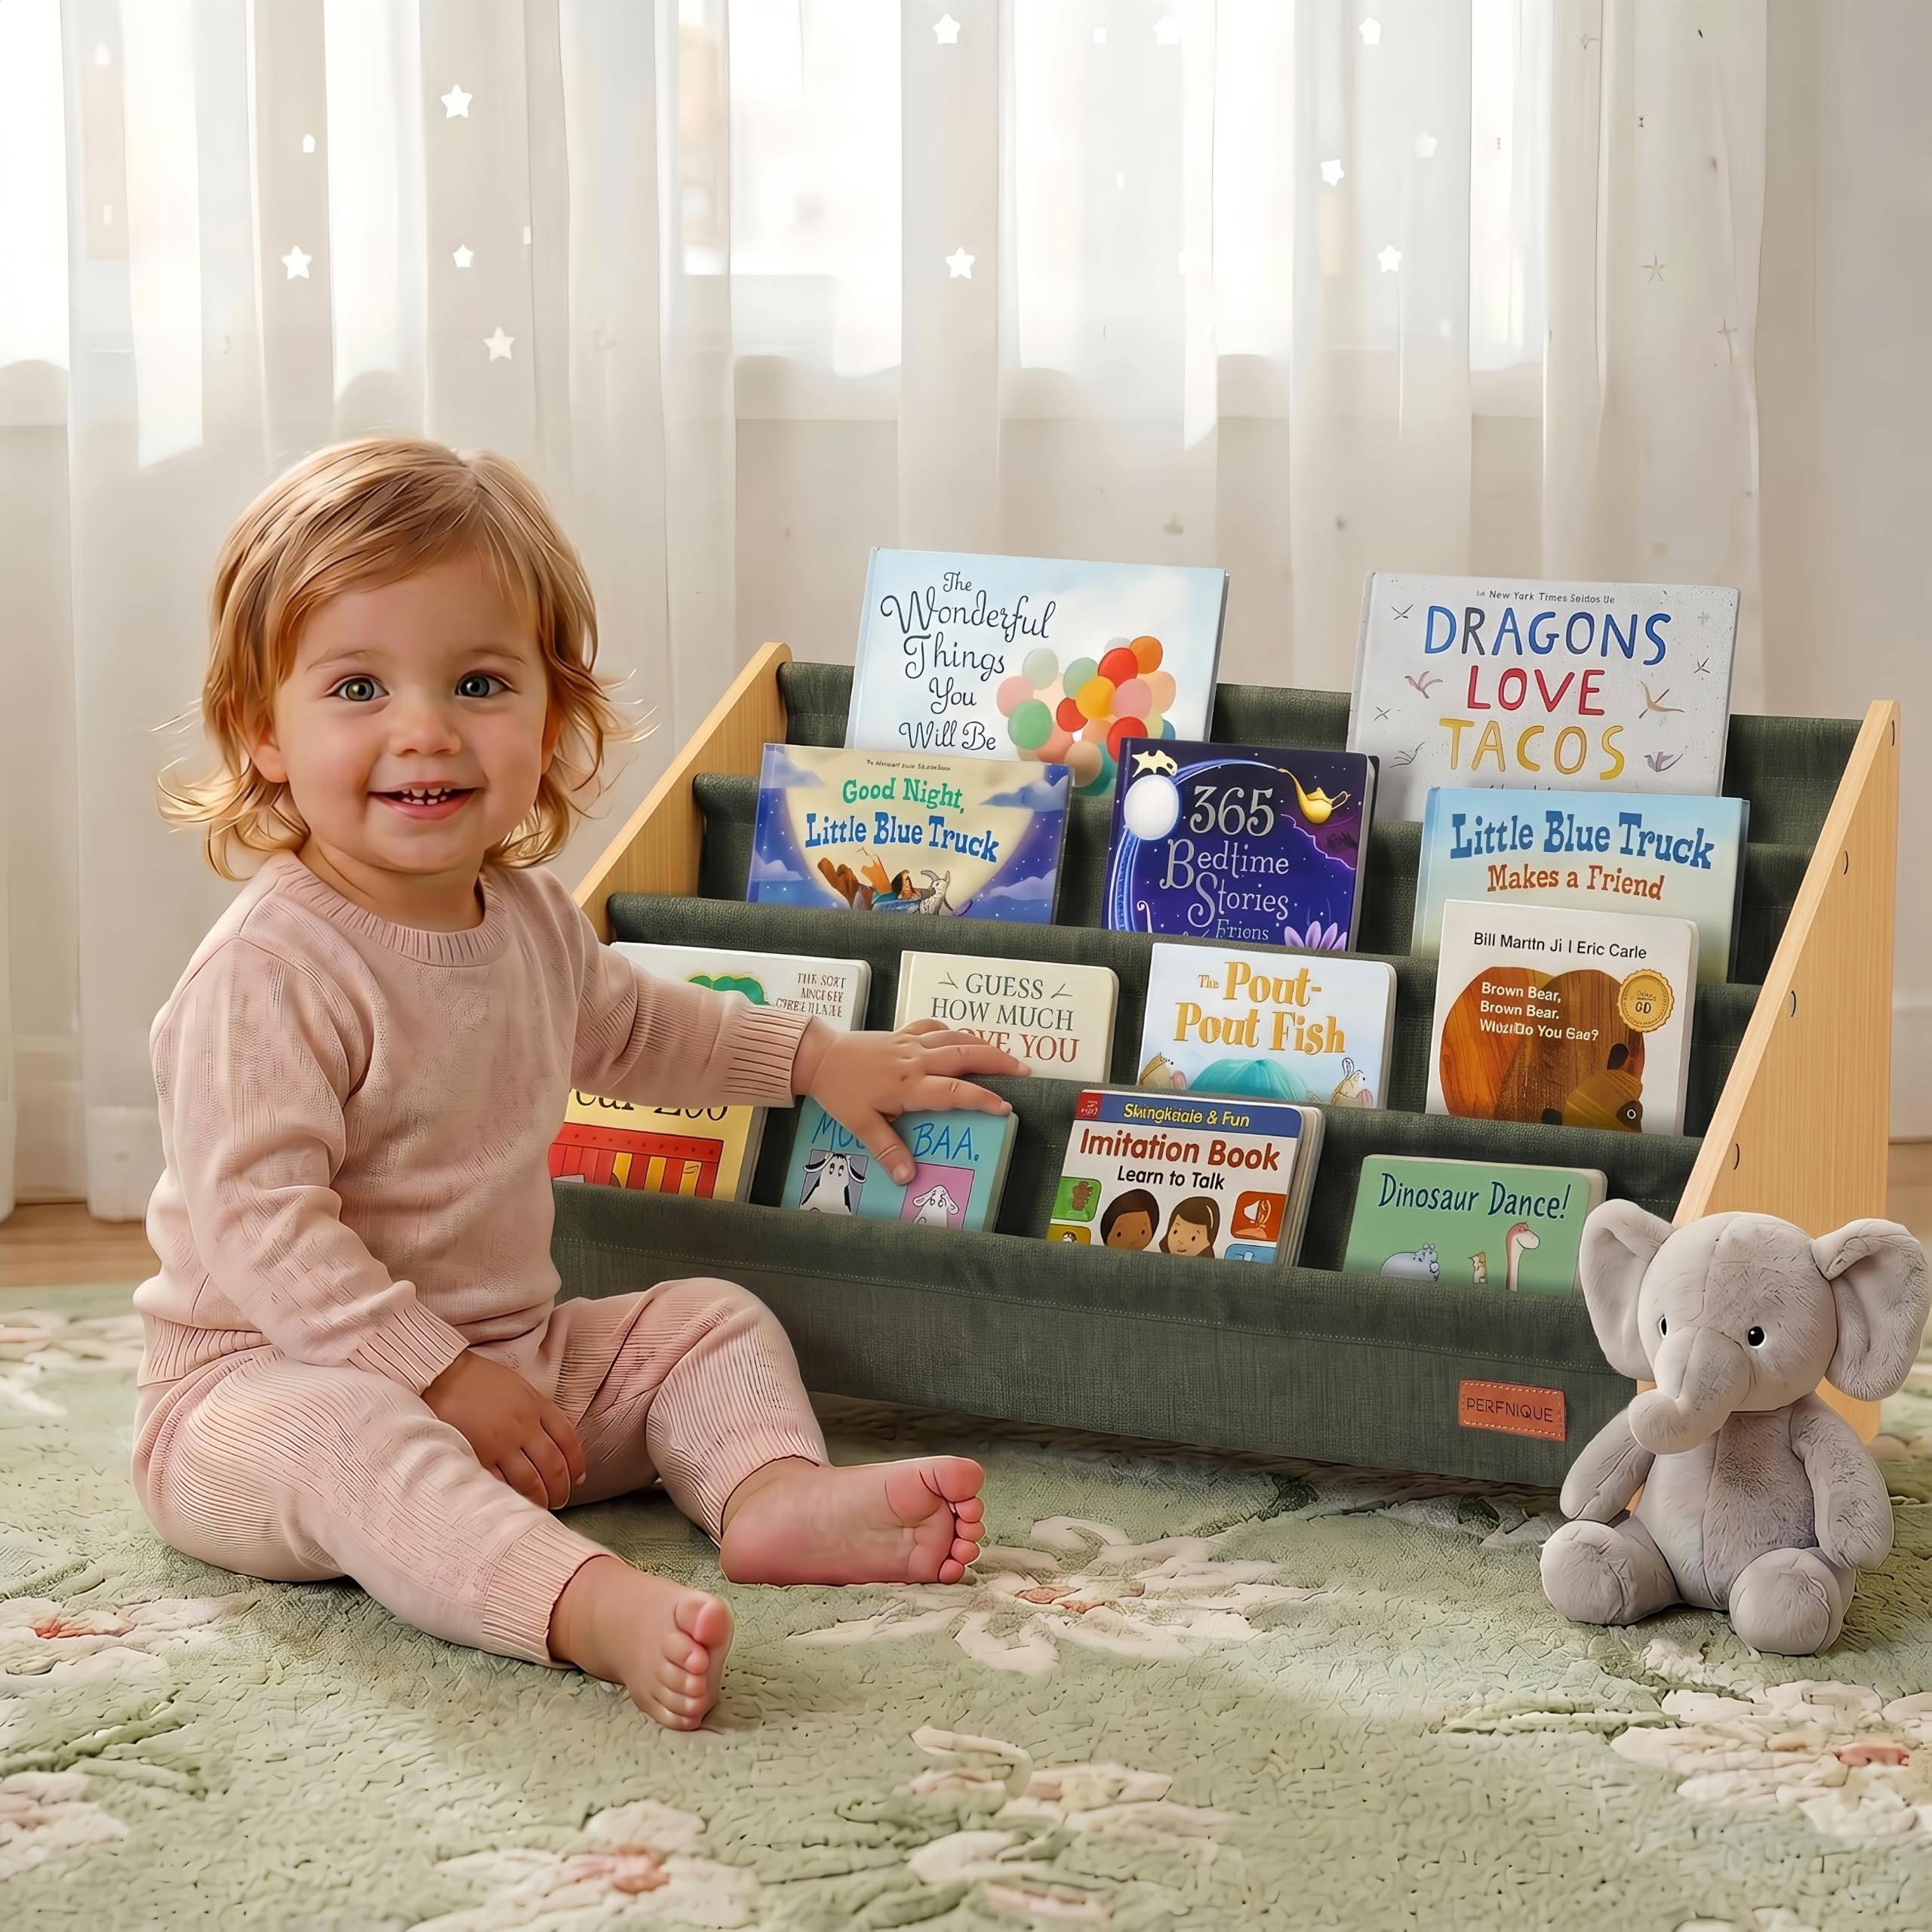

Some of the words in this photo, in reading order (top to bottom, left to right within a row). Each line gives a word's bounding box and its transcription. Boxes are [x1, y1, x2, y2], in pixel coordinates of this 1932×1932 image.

[943, 571, 972, 592] The
[1489, 590, 1510, 599] New
[1539, 592, 1567, 602] Times
[880, 586, 1056, 643] Wonderful
[1424, 605, 1672, 666] DRAGONS
[903, 632, 1005, 681] Things
[929, 677, 977, 715] You
[1467, 664, 1605, 715] LOVE
[899, 720, 958, 750] Will
[961, 721, 996, 751] Be
[1438, 718, 1626, 780] TACOS
[842, 777, 897, 804] Good
[902, 777, 964, 814] Night,
[1189, 785, 1275, 836] 365
[804, 812, 867, 848] Little
[873, 811, 923, 844] Blue
[928, 815, 1000, 863] Truck
[1450, 813, 1534, 860] Little
[1543, 810, 1611, 853] Blue
[1619, 811, 1715, 869] Truck
[1159, 838, 1289, 889] Bedtime
[1487, 863, 1559, 893] Makes
[1566, 870, 1579, 888] a
[1586, 864, 1666, 900] Friend
[1187, 872, 1289, 928] Stories
[1473, 931, 1496, 946] Bill
[1577, 941, 1605, 955] Eric
[1609, 943, 1647, 959] Carle
[965, 973, 1043, 1000] GUESS
[1198, 974, 1220, 989] The
[1222, 961, 1322, 1008] Pout-
[1481, 981, 1524, 998] Brown
[1527, 986, 1561, 1004] Bear,
[931, 997, 990, 1024] HOW
[996, 1004, 1075, 1031] MUCH
[1173, 1001, 1260, 1048] Pout
[1268, 1011, 1346, 1055] Fish
[1480, 1000, 1522, 1015] Brown
[1526, 1004, 1559, 1019] Bear.
[1019, 1034, 1080, 1063] YOU
[1537, 1025, 1562, 1038] You
[1207, 1109, 1218, 1124] &
[1221, 1111, 1250, 1128] Fun
[912, 1122, 980, 1162] BAA.
[1080, 1128, 1200, 1164] Imitation
[1208, 1140, 1281, 1171] Book
[1117, 1165, 1164, 1185] Learn
[1169, 1171, 1185, 1186] to
[1192, 1171, 1225, 1190] Talk
[1378, 1172, 1479, 1212] Dinosaur
[1487, 1181, 1571, 1220] Dance!
[1466, 1397, 1553, 1423] PERFNIQUE
